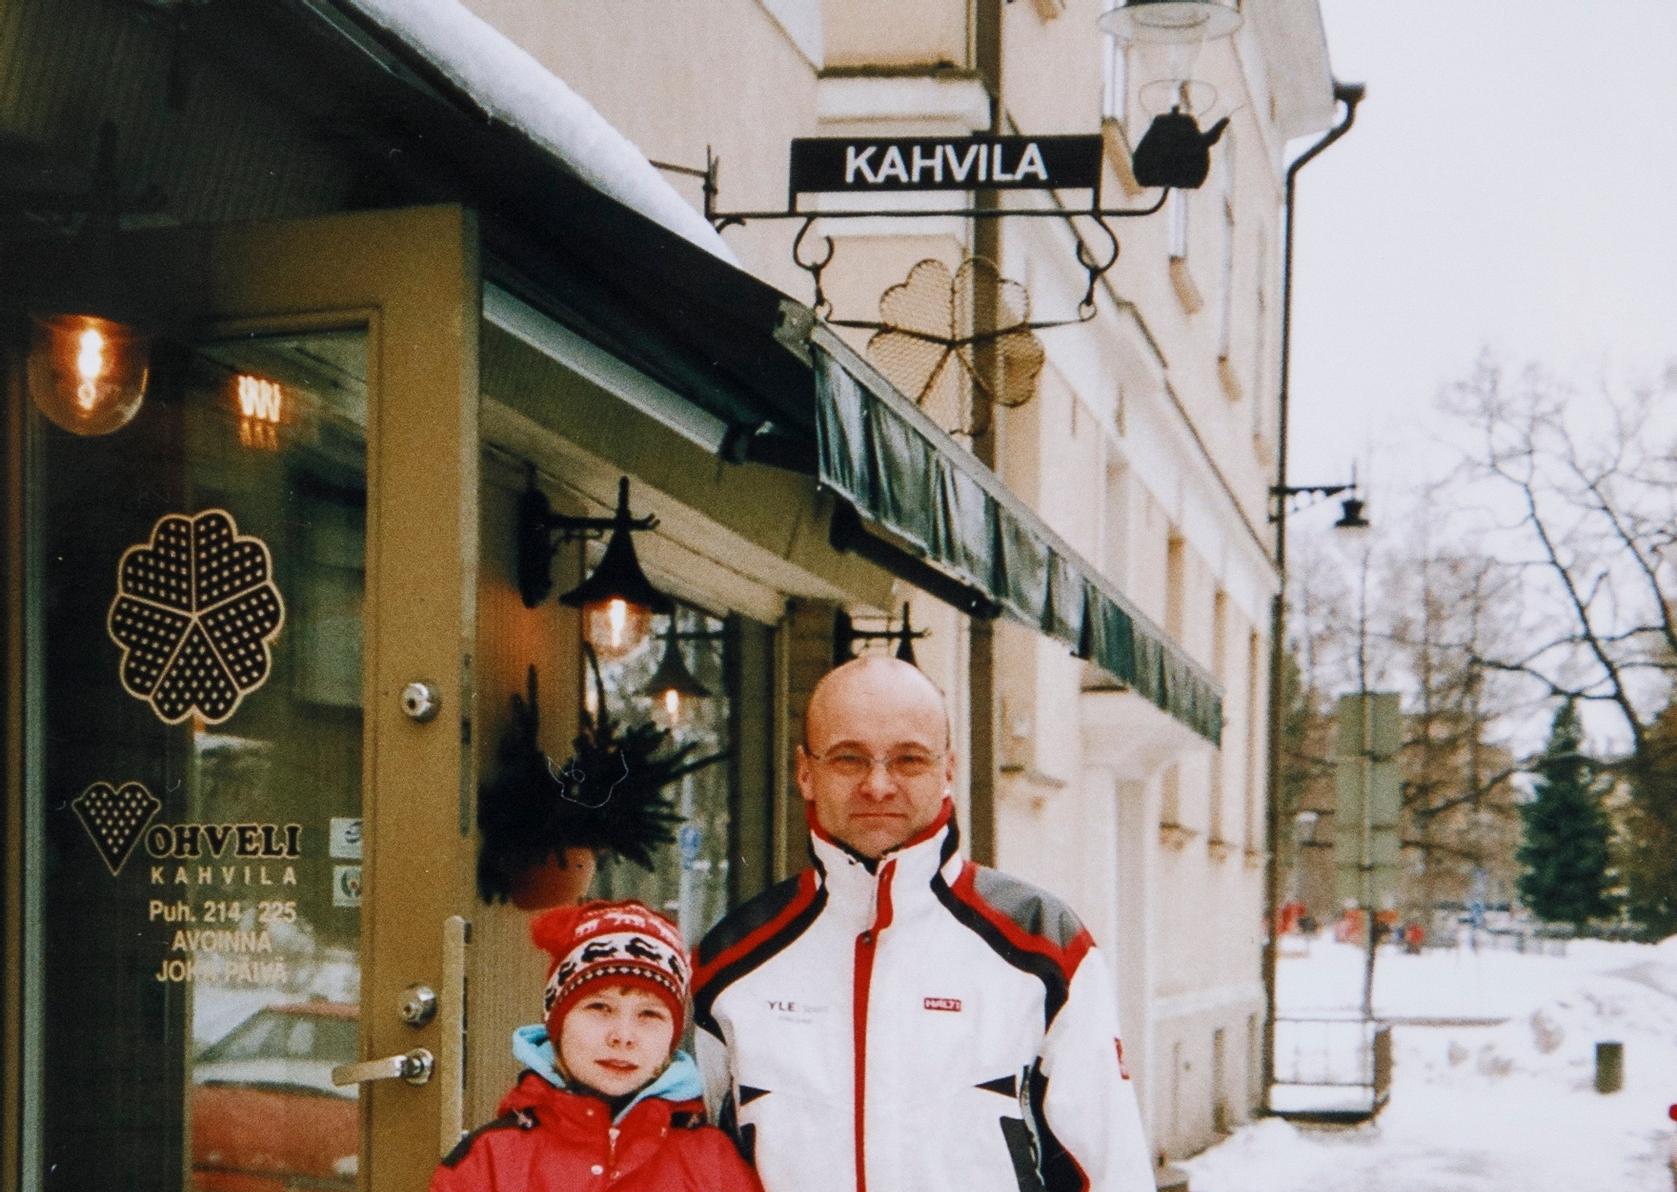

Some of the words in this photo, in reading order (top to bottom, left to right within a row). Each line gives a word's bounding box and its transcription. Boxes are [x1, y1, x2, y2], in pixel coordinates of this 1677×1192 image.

[844, 143, 1048, 184] KAHVILA
[151, 866, 297, 885] KAHVILA
[150, 900, 196, 922] Puh.
[204, 901, 241, 922] 214
[258, 901, 297, 923] 225
[172, 929, 272, 952] AVOINNA
[155, 959, 217, 982] JOK
[767, 1000, 796, 1013] YLE
